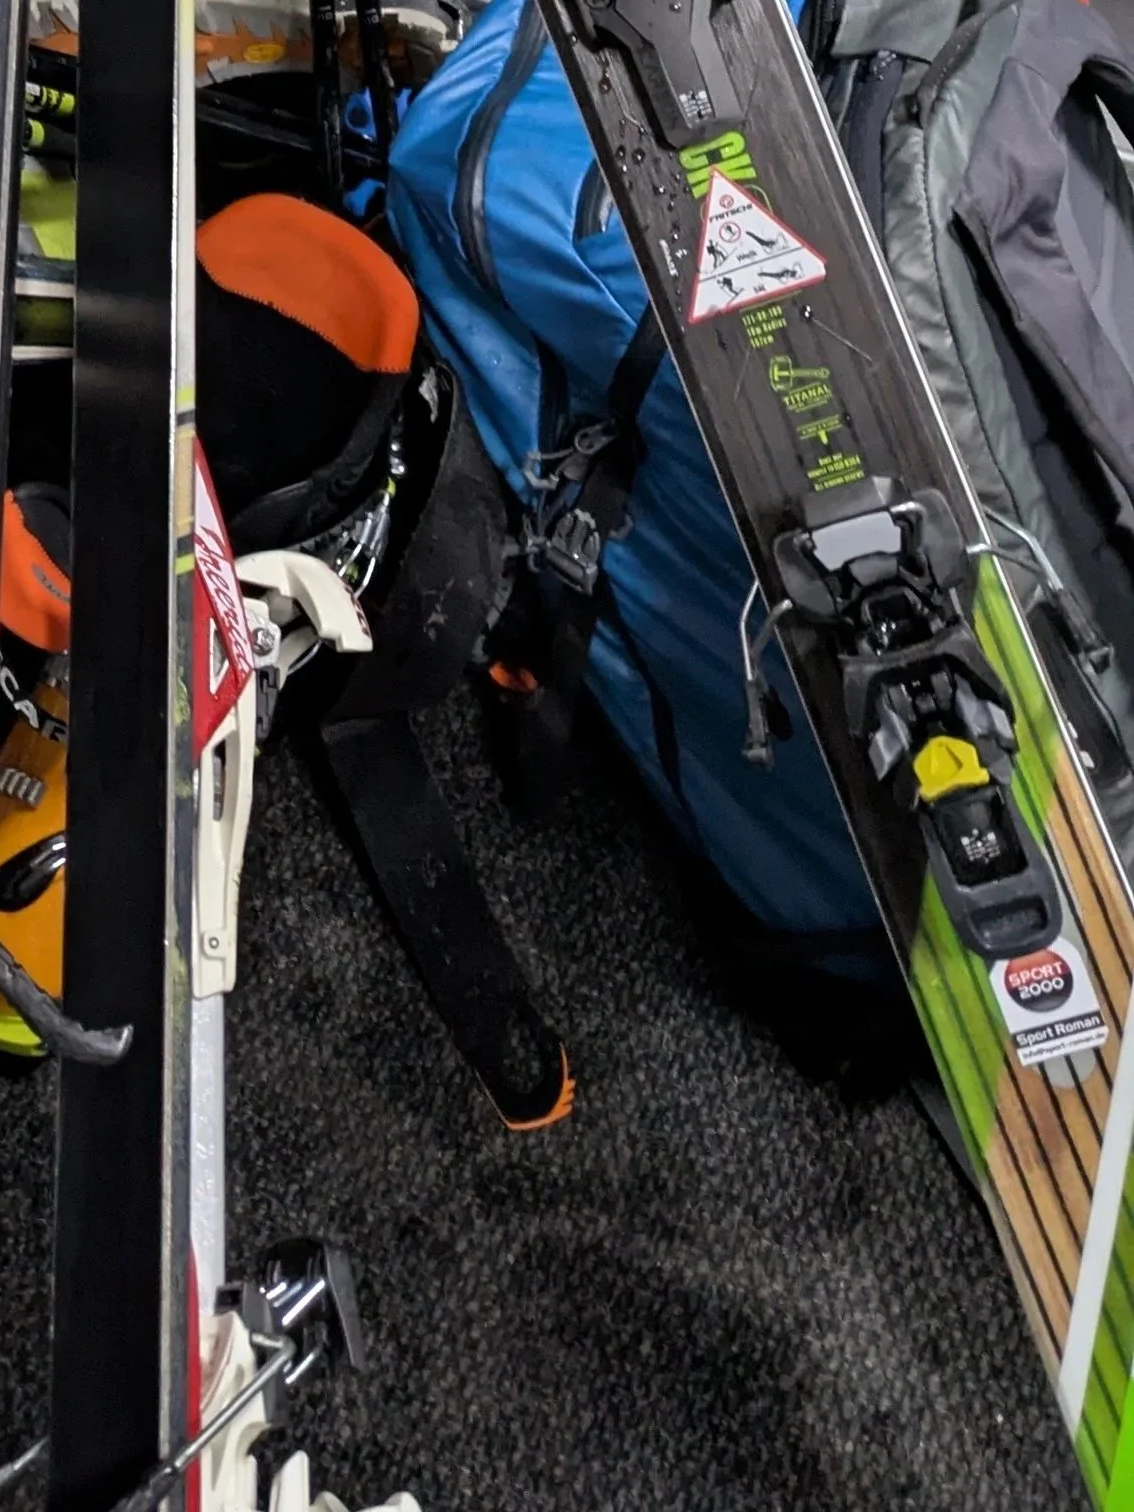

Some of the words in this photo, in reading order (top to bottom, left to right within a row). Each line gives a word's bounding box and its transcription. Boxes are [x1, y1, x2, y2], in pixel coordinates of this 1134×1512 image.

[736, 250, 758, 262] Walk
[783, 384, 830, 406] TITANAL
[1008, 961, 1064, 988] SPORT
[1018, 977, 1065, 1000] 2000
[1016, 1028, 1054, 1047] Sport
[1054, 1016, 1101, 1036] Roman
